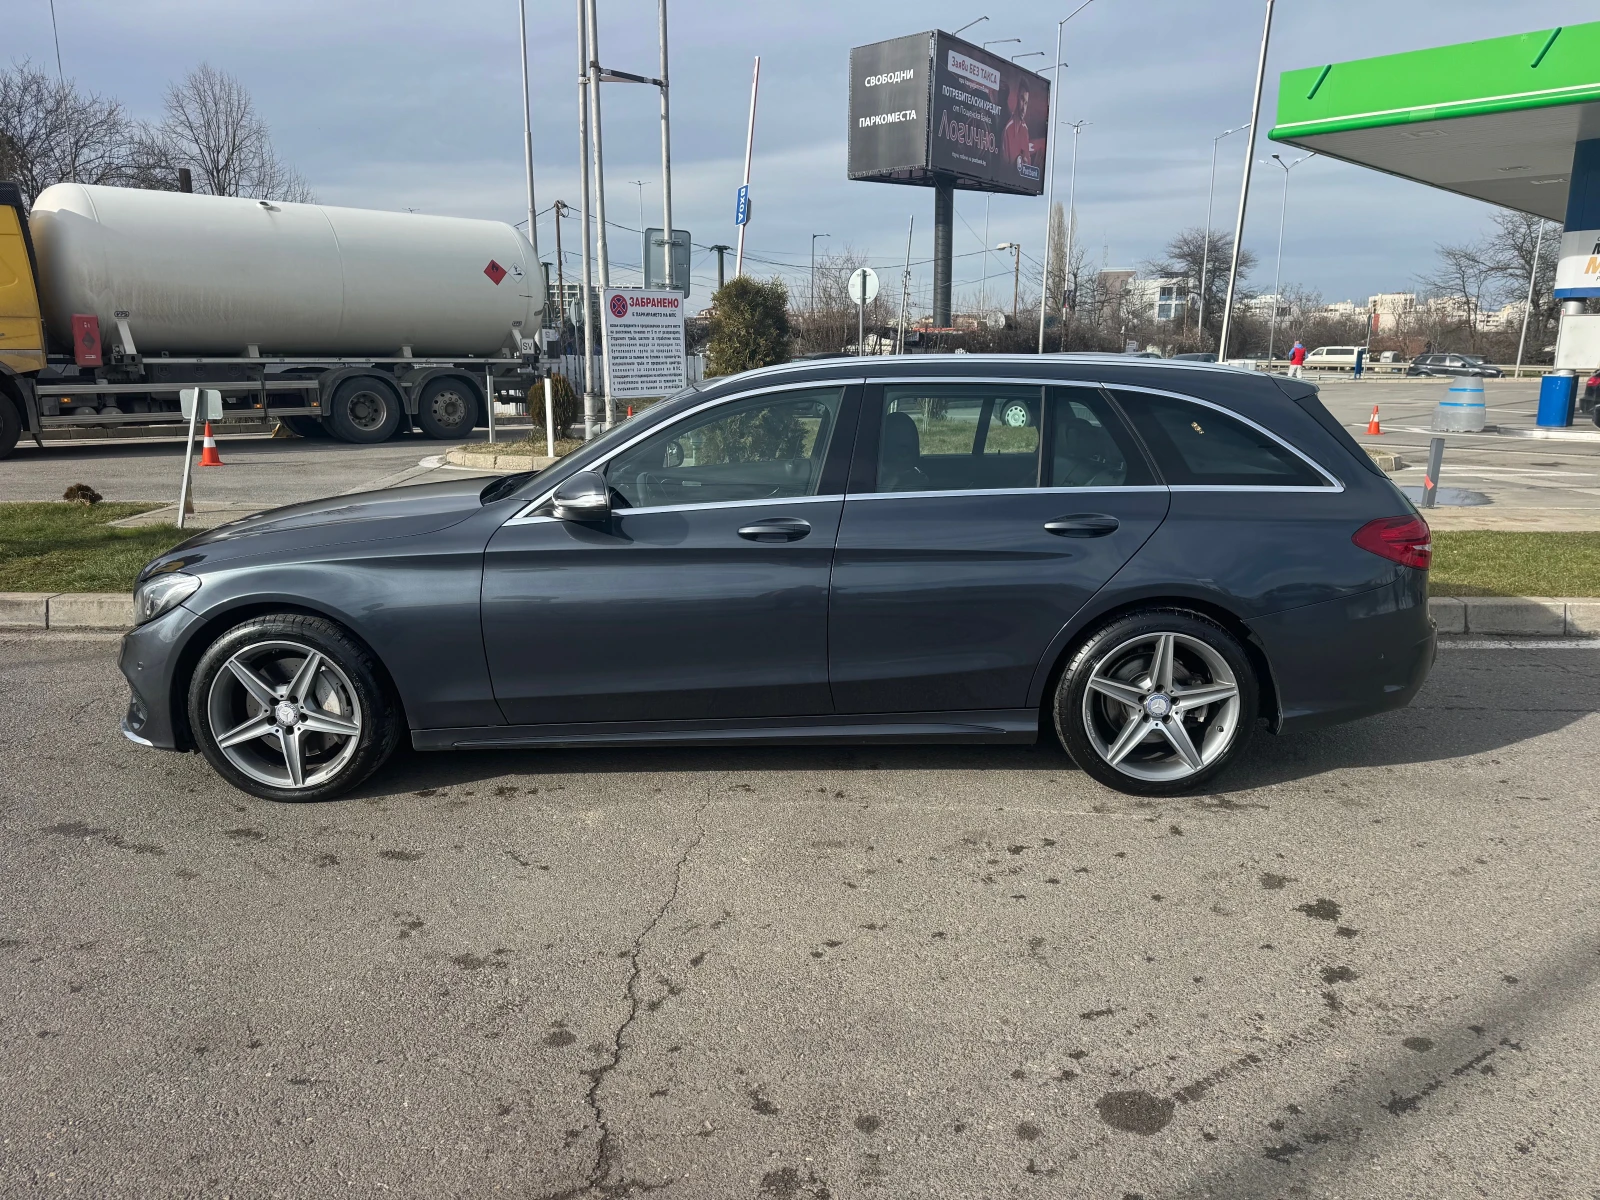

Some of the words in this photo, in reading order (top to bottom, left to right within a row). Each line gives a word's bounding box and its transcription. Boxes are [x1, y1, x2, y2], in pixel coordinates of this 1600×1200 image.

[864, 68, 914, 87] СВОБОДНИ
[952, 56, 968, 72] Заяви
[969, 63, 980, 77] БЕЗ
[980, 68, 997, 84] ТАКСА
[942, 85, 984, 108] ПОТРЕБИТЕЛСКИ
[984, 100, 1002, 116] КРЕДИТ
[859, 110, 917, 128] ПАРКОМЕСТА
[953, 104, 960, 113] от
[960, 106, 980, 120] Пощенска
[938, 110, 998, 154] Логично.
[1022, 166, 1038, 177] Postbank
[629, 297, 679, 308] ЗАБРАНЕНО
[523, 342, 532, 350] SV
